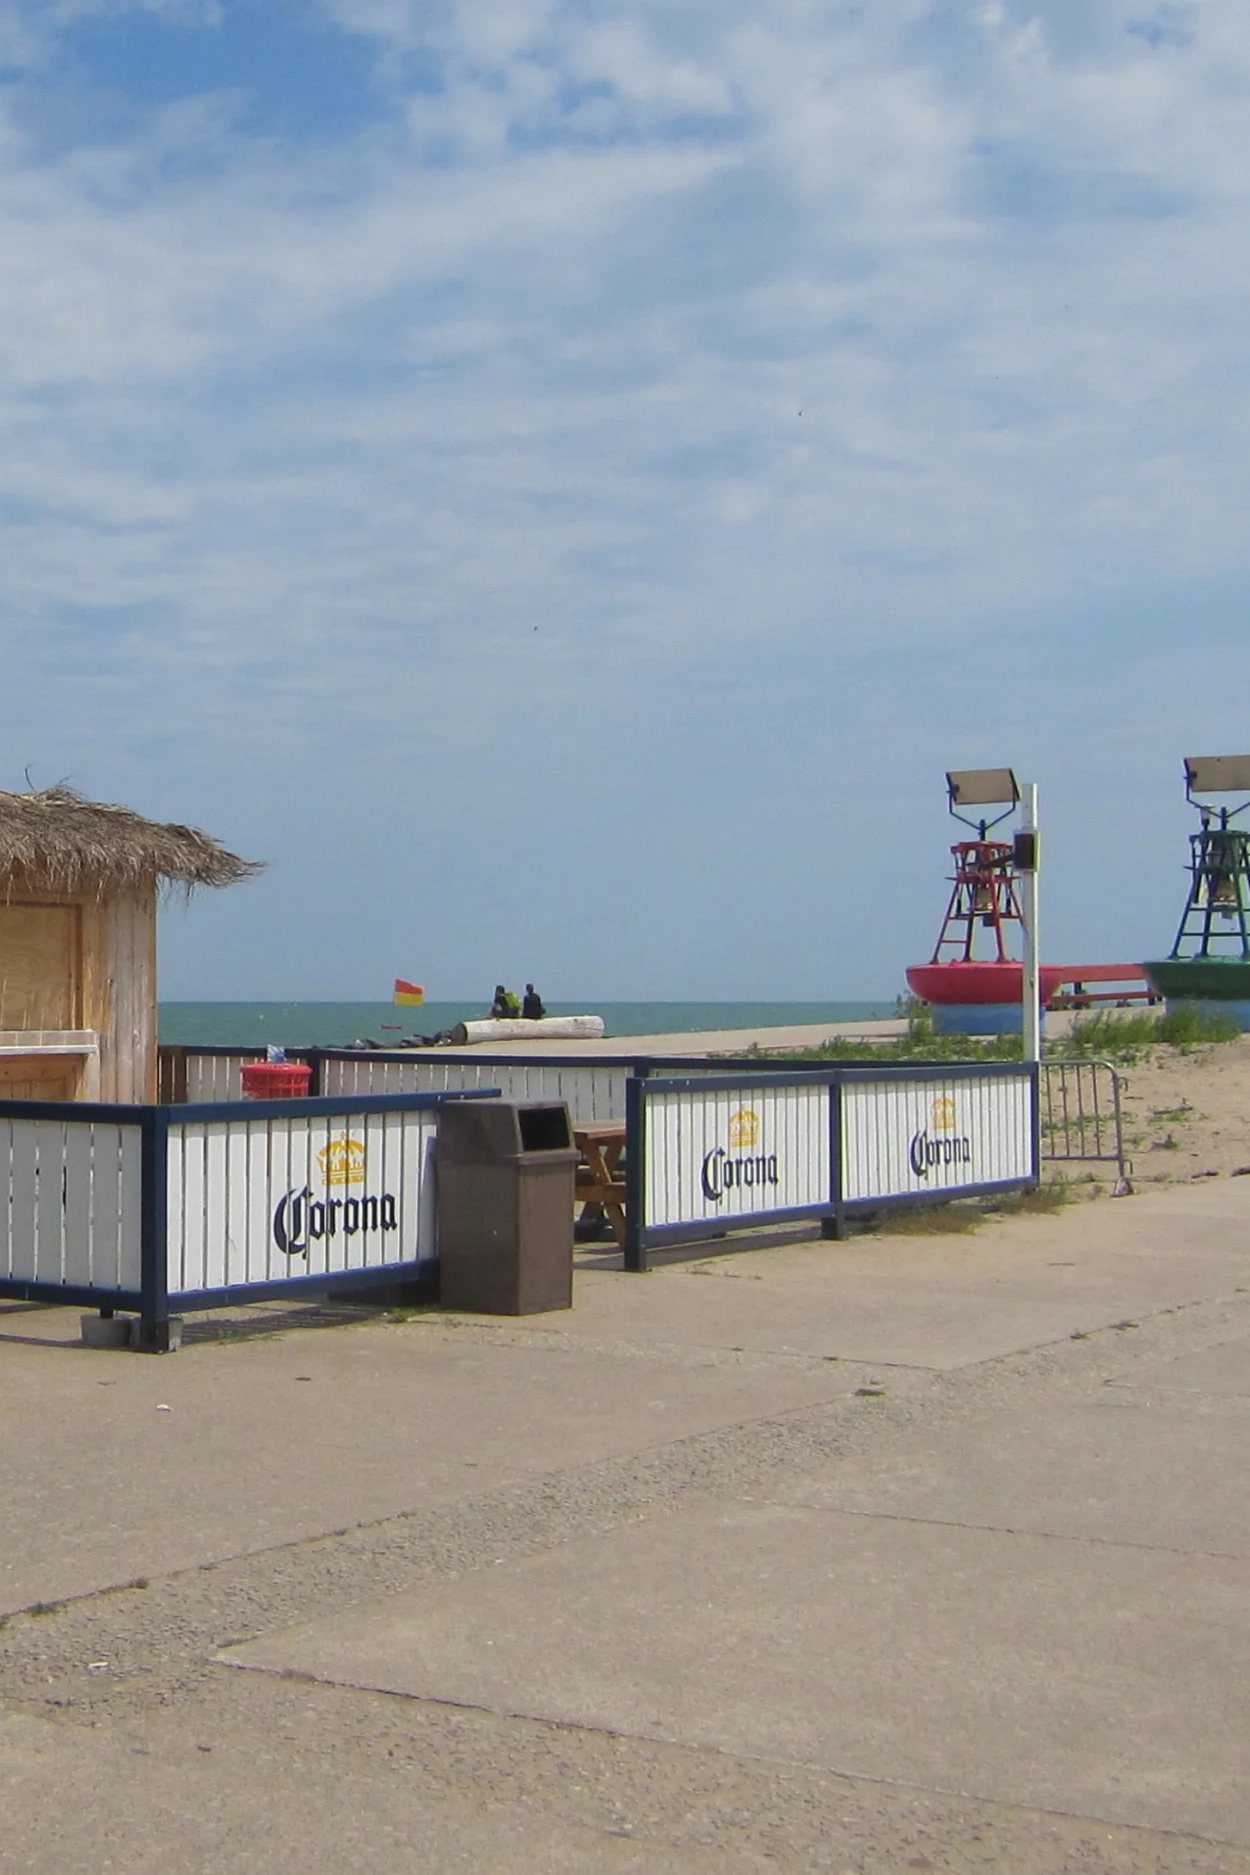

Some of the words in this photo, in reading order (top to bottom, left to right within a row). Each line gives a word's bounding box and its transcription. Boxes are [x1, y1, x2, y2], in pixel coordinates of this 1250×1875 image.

[701, 1147, 779, 1206] Corona
[910, 1129, 971, 1181] Corona
[274, 1184, 397, 1260] Corona
